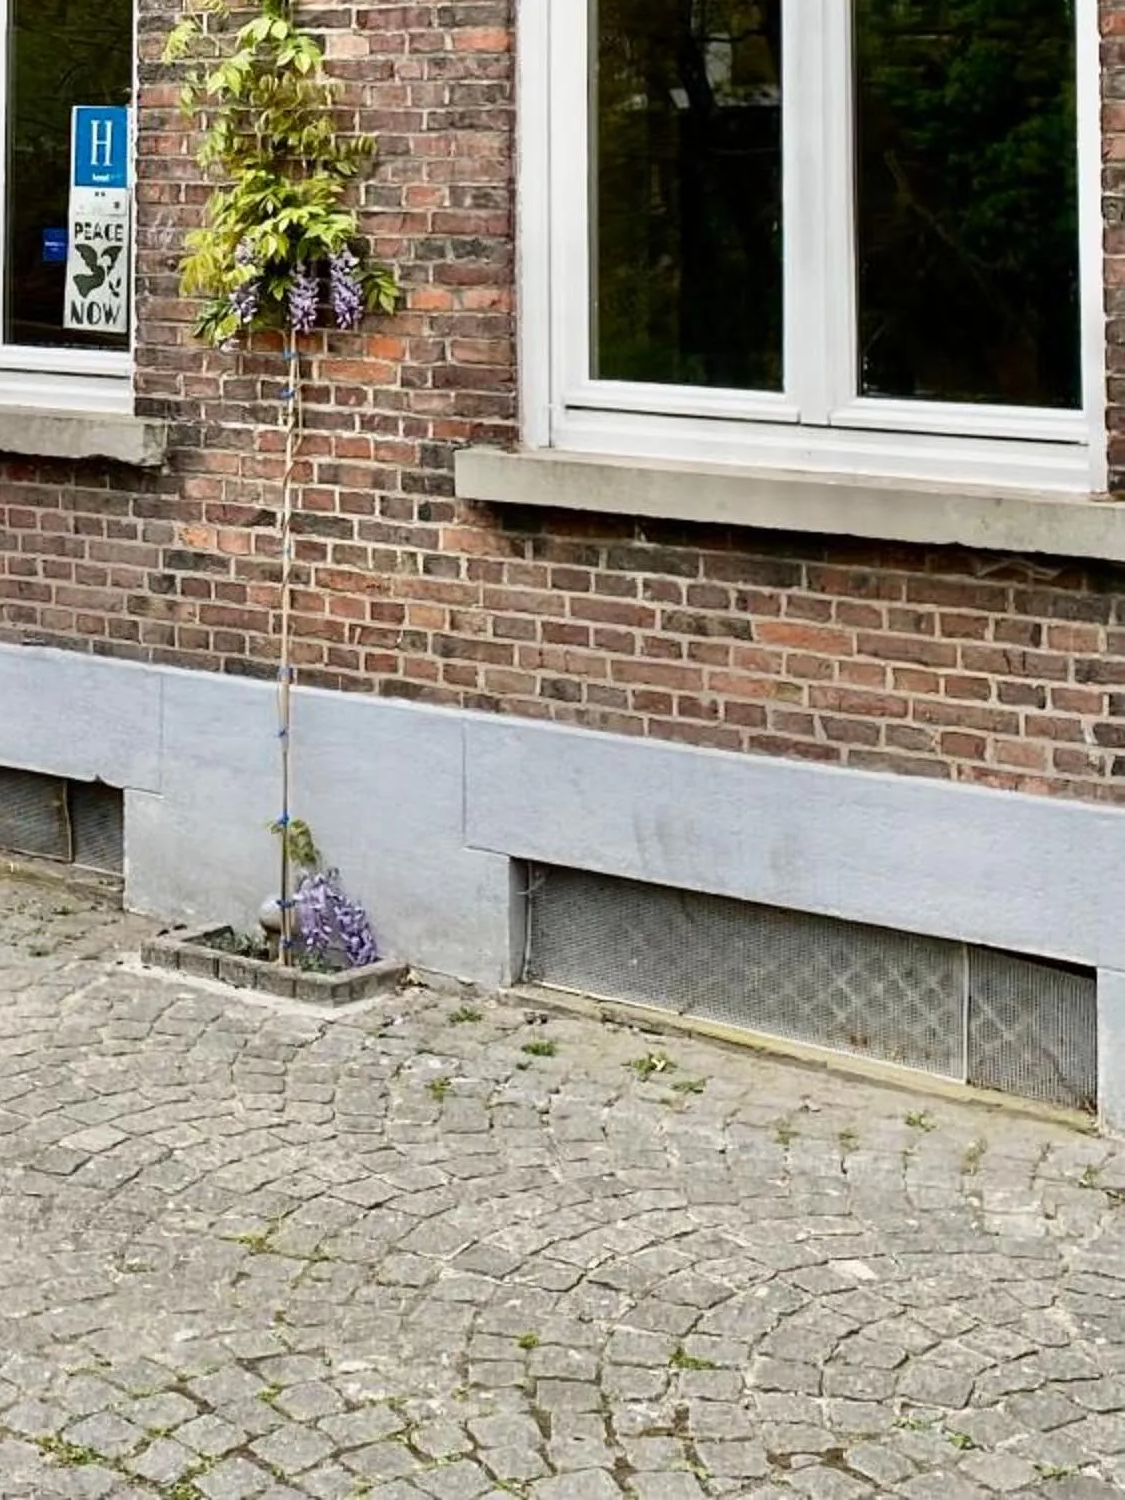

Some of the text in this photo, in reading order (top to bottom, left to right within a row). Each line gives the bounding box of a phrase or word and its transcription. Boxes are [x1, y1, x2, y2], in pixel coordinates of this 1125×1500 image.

[90, 119, 113, 167] H
[74, 221, 124, 242] PEACE
[70, 299, 121, 325] NOW
